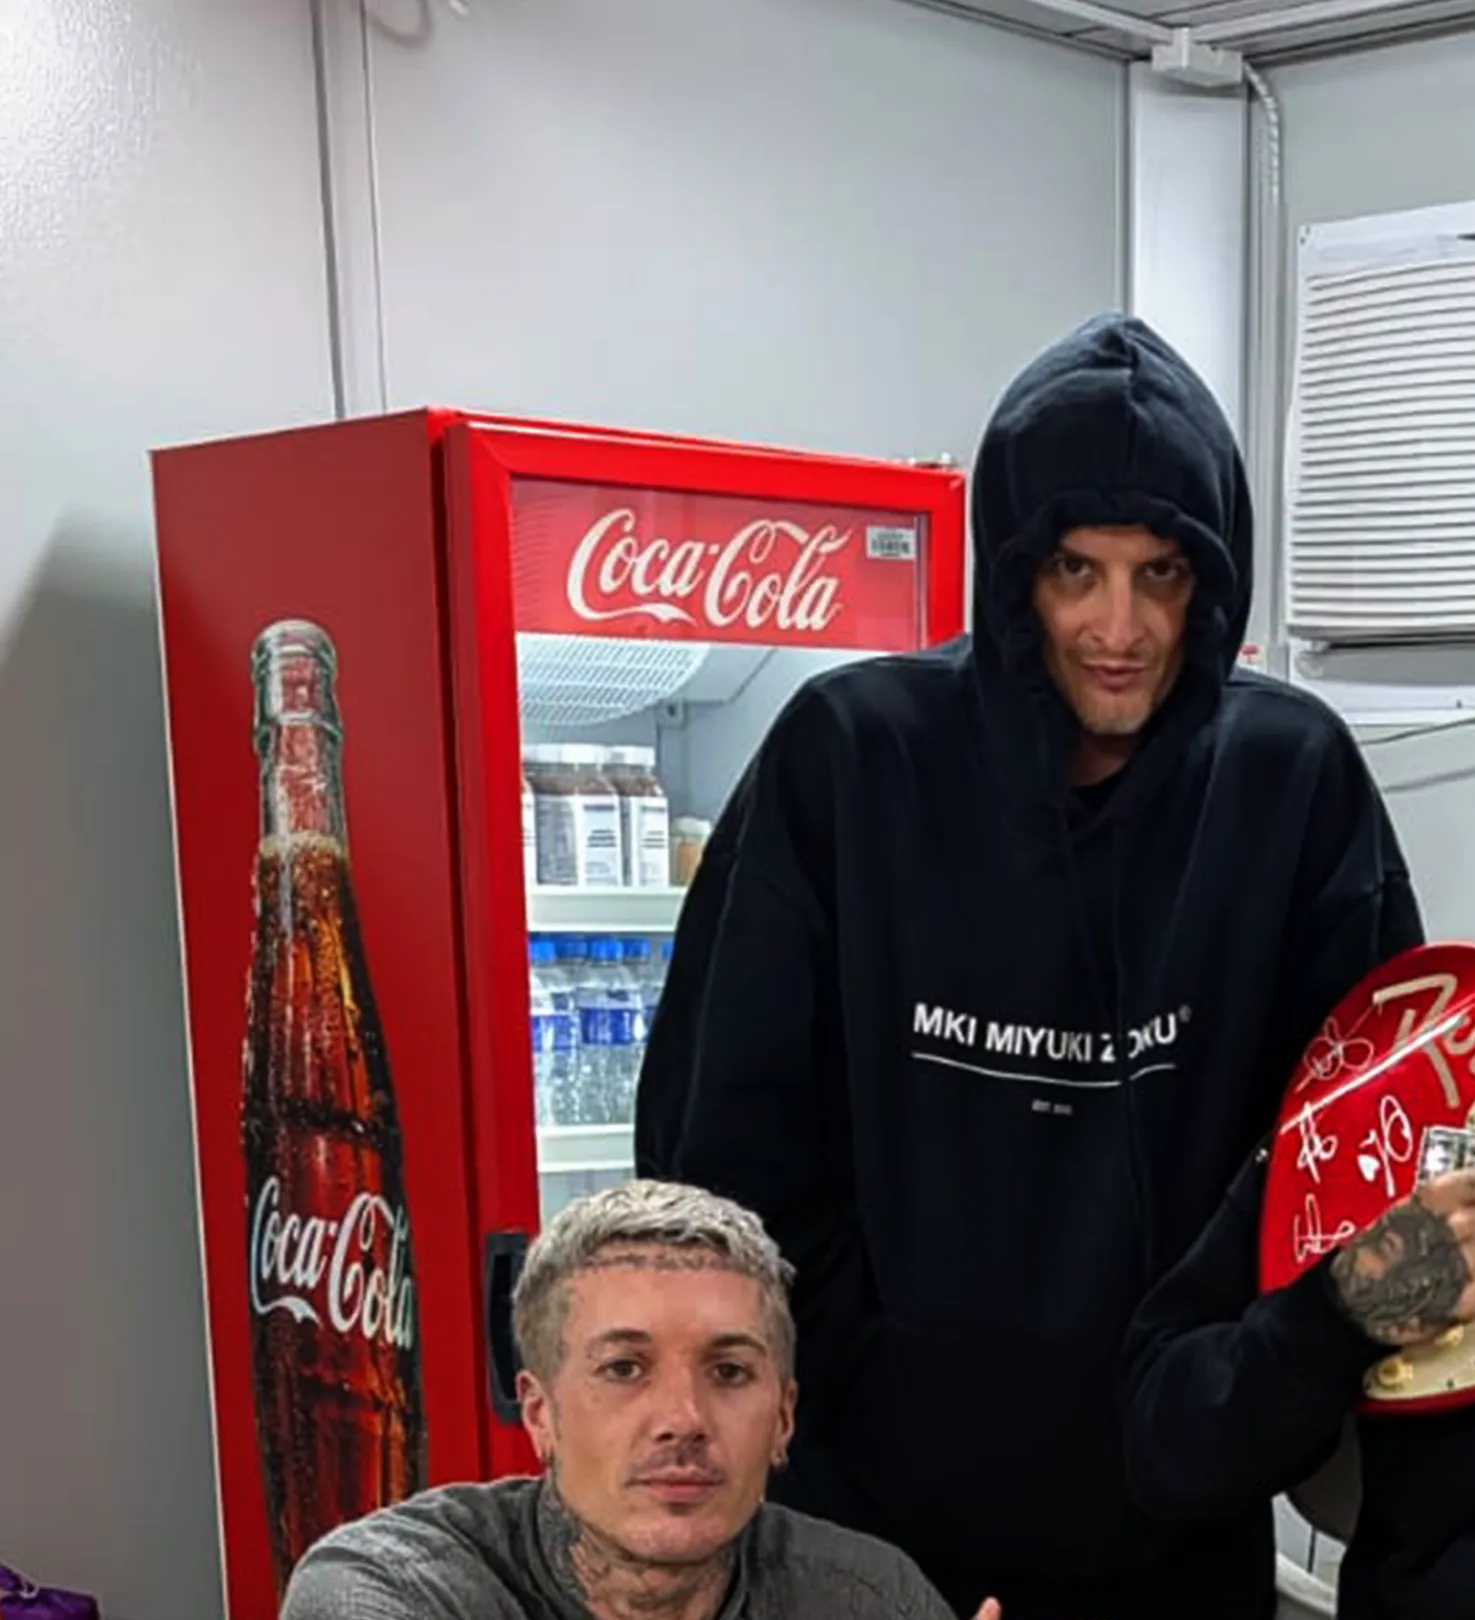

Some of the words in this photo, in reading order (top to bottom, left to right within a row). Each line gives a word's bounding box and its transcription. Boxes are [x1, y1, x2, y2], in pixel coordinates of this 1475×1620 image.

[566, 507, 851, 631] Coca-Cola
[912, 1001, 977, 1047] MKI
[985, 1020, 1092, 1063] MIYUKI
[251, 1176, 414, 1350] Coca-Cola
